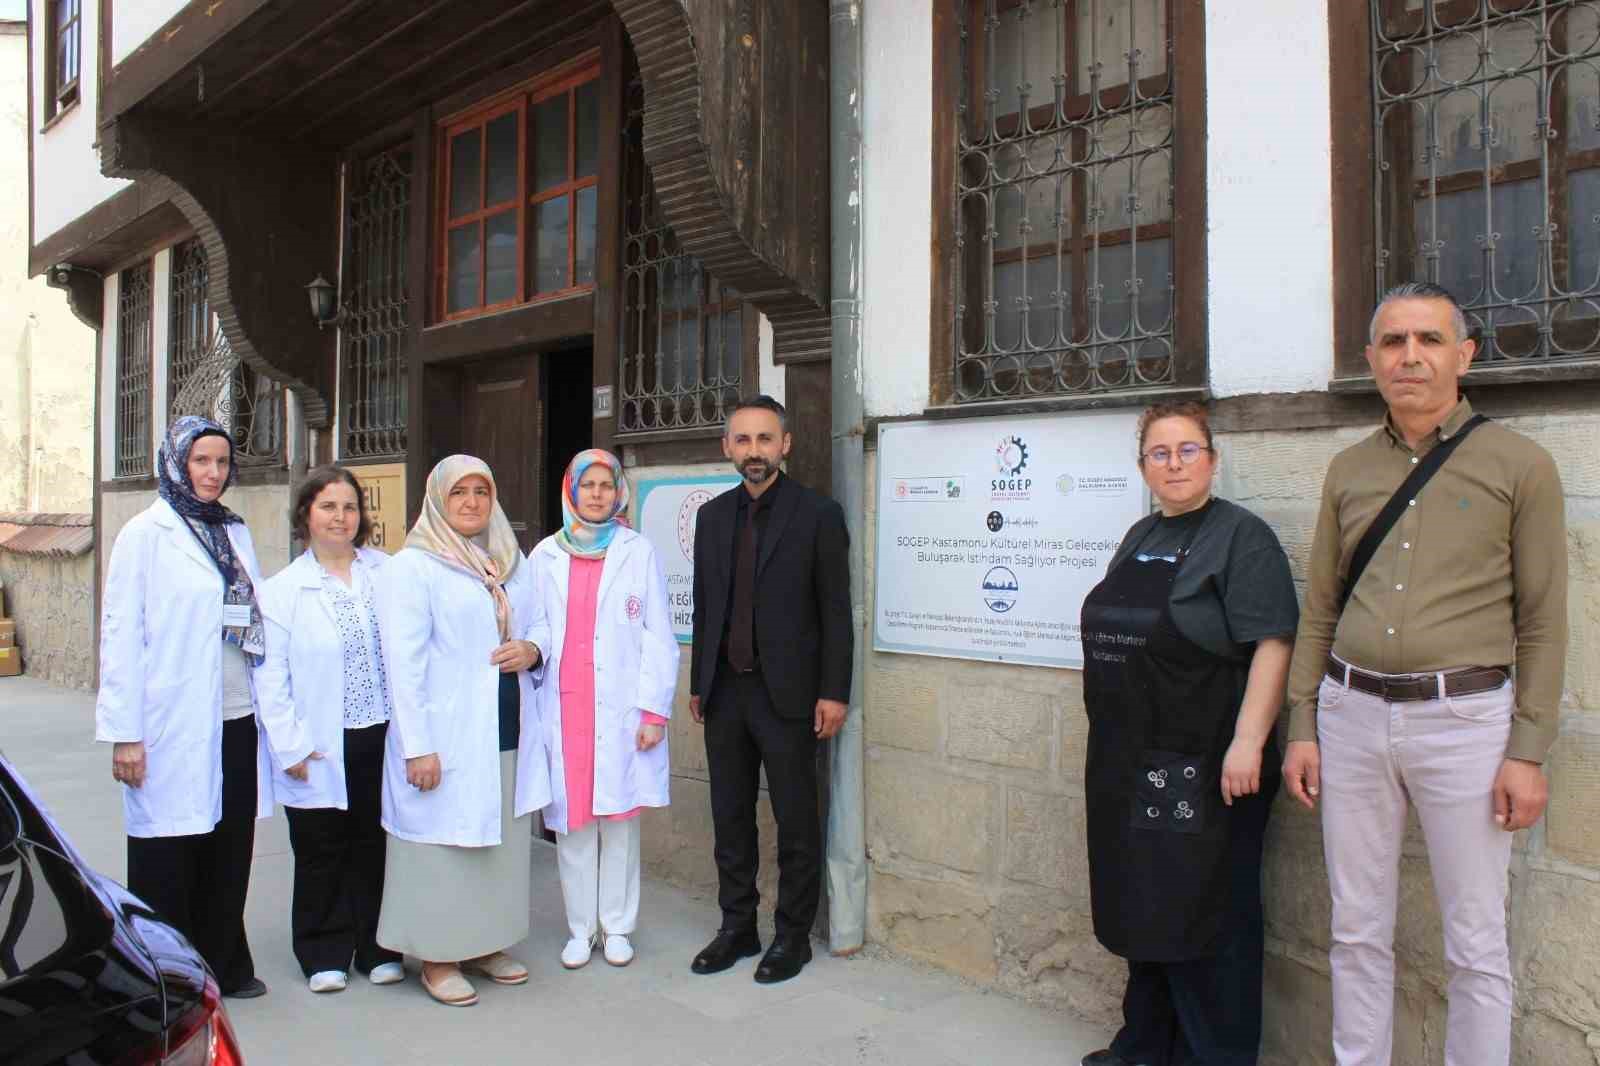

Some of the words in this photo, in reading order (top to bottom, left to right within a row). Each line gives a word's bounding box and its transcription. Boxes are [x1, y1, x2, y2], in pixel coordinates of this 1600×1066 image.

[991, 478, 1032, 491] SOGEP
[897, 535, 930, 547] SOGEP
[931, 536, 988, 549] Kastamonu
[1034, 537, 1064, 550] Miras
[1059, 555, 1097, 569] Projesi
